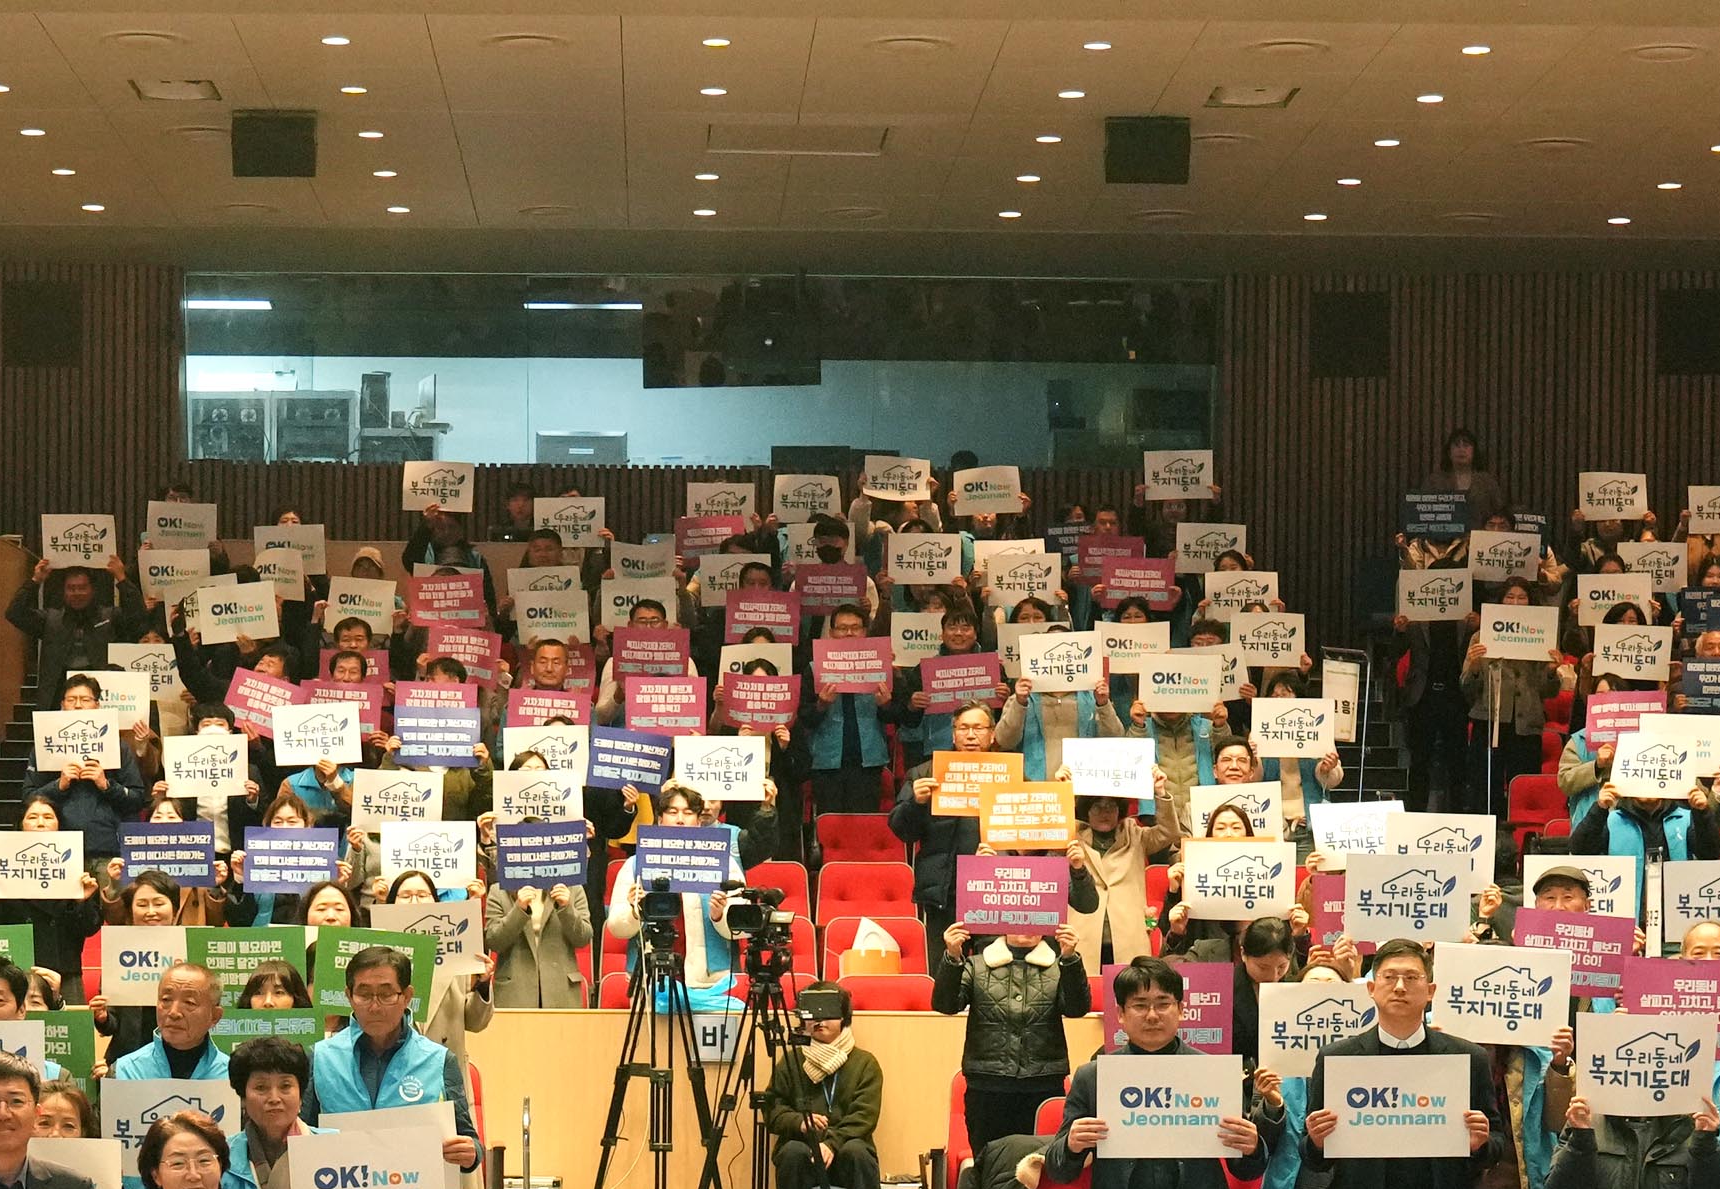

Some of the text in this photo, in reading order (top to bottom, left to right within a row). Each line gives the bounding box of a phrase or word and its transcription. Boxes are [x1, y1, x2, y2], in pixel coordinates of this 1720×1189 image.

[1028, 661, 1088, 684] 복지기동대
[1261, 721, 1319, 747] 복지기동대
[173, 760, 233, 786] 복지기동대
[1619, 758, 1683, 787] 복지기동대
[410, 843, 452, 855] 우리동네
[391, 850, 458, 878] 복지기동대
[1219, 867, 1268, 882] 우리동네
[983, 894, 1040, 905] GO! GO! GO!
[1196, 874, 1274, 909] 복지기동대
[1386, 881, 1442, 900] 우리동네
[1358, 889, 1447, 930] 복지기동대
[119, 950, 159, 967] OK!
[1475, 978, 1536, 997] 우리동네
[1448, 985, 1542, 1030] 복지기동대
[701, 1029, 729, 1050] 바
[1619, 1048, 1683, 1066] 우리동네
[1590, 1055, 1690, 1100] 복지기동대
[1120, 1086, 1219, 1109] OK! Now
[1346, 1086, 1446, 1109] OK! Now
[1122, 1111, 1219, 1126] Jeonnam
[1348, 1111, 1446, 1126] Jeonnam
[314, 1165, 419, 1189] OK! Now
